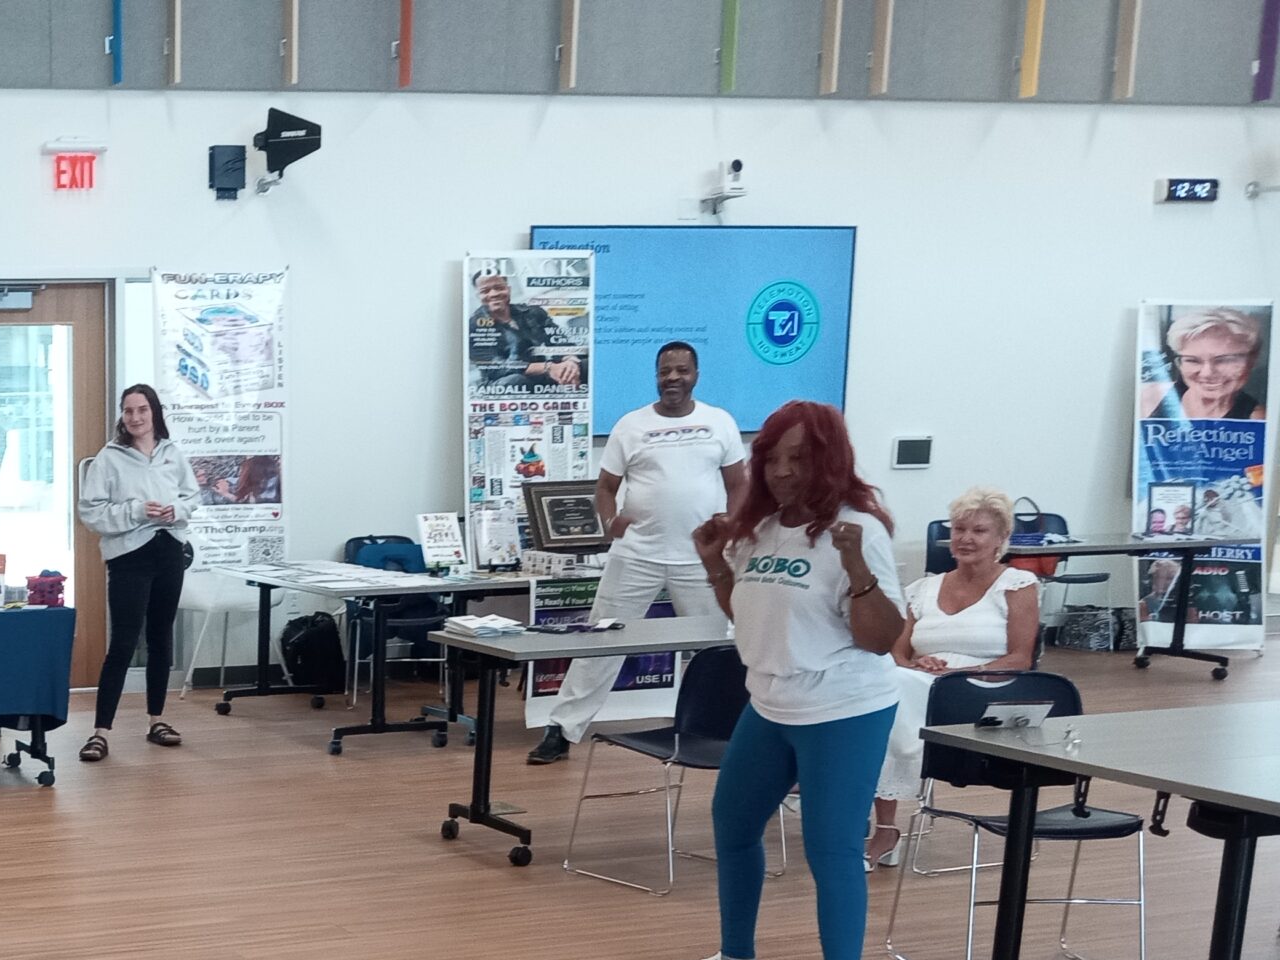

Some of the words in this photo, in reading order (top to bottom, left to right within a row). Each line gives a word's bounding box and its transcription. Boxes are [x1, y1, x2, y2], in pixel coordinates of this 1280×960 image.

[56, 155, 96, 189] EXIT
[481, 259, 587, 277] BLACK
[161, 273, 284, 284] FUN-ERAPY
[530, 278, 583, 286] AUTHORS
[174, 288, 253, 300] CARDS
[753, 288, 814, 317] TELEMOTION
[757, 340, 770, 354] NO
[774, 341, 806, 358] SWEAT
[469, 385, 530, 395] RANDALL
[534, 384, 588, 394] DANIELS
[471, 403, 495, 412] THE
[500, 402, 539, 412] BOBO
[543, 401, 579, 411] GAME
[1145, 424, 1256, 447] Reflections
[1193, 443, 1254, 462] Angel
[744, 555, 811, 578] BOBO
[1192, 566, 1229, 575] ADIO
[1199, 611, 1243, 622] HOST
[635, 674, 660, 684] USE
[662, 673, 673, 682] IT
